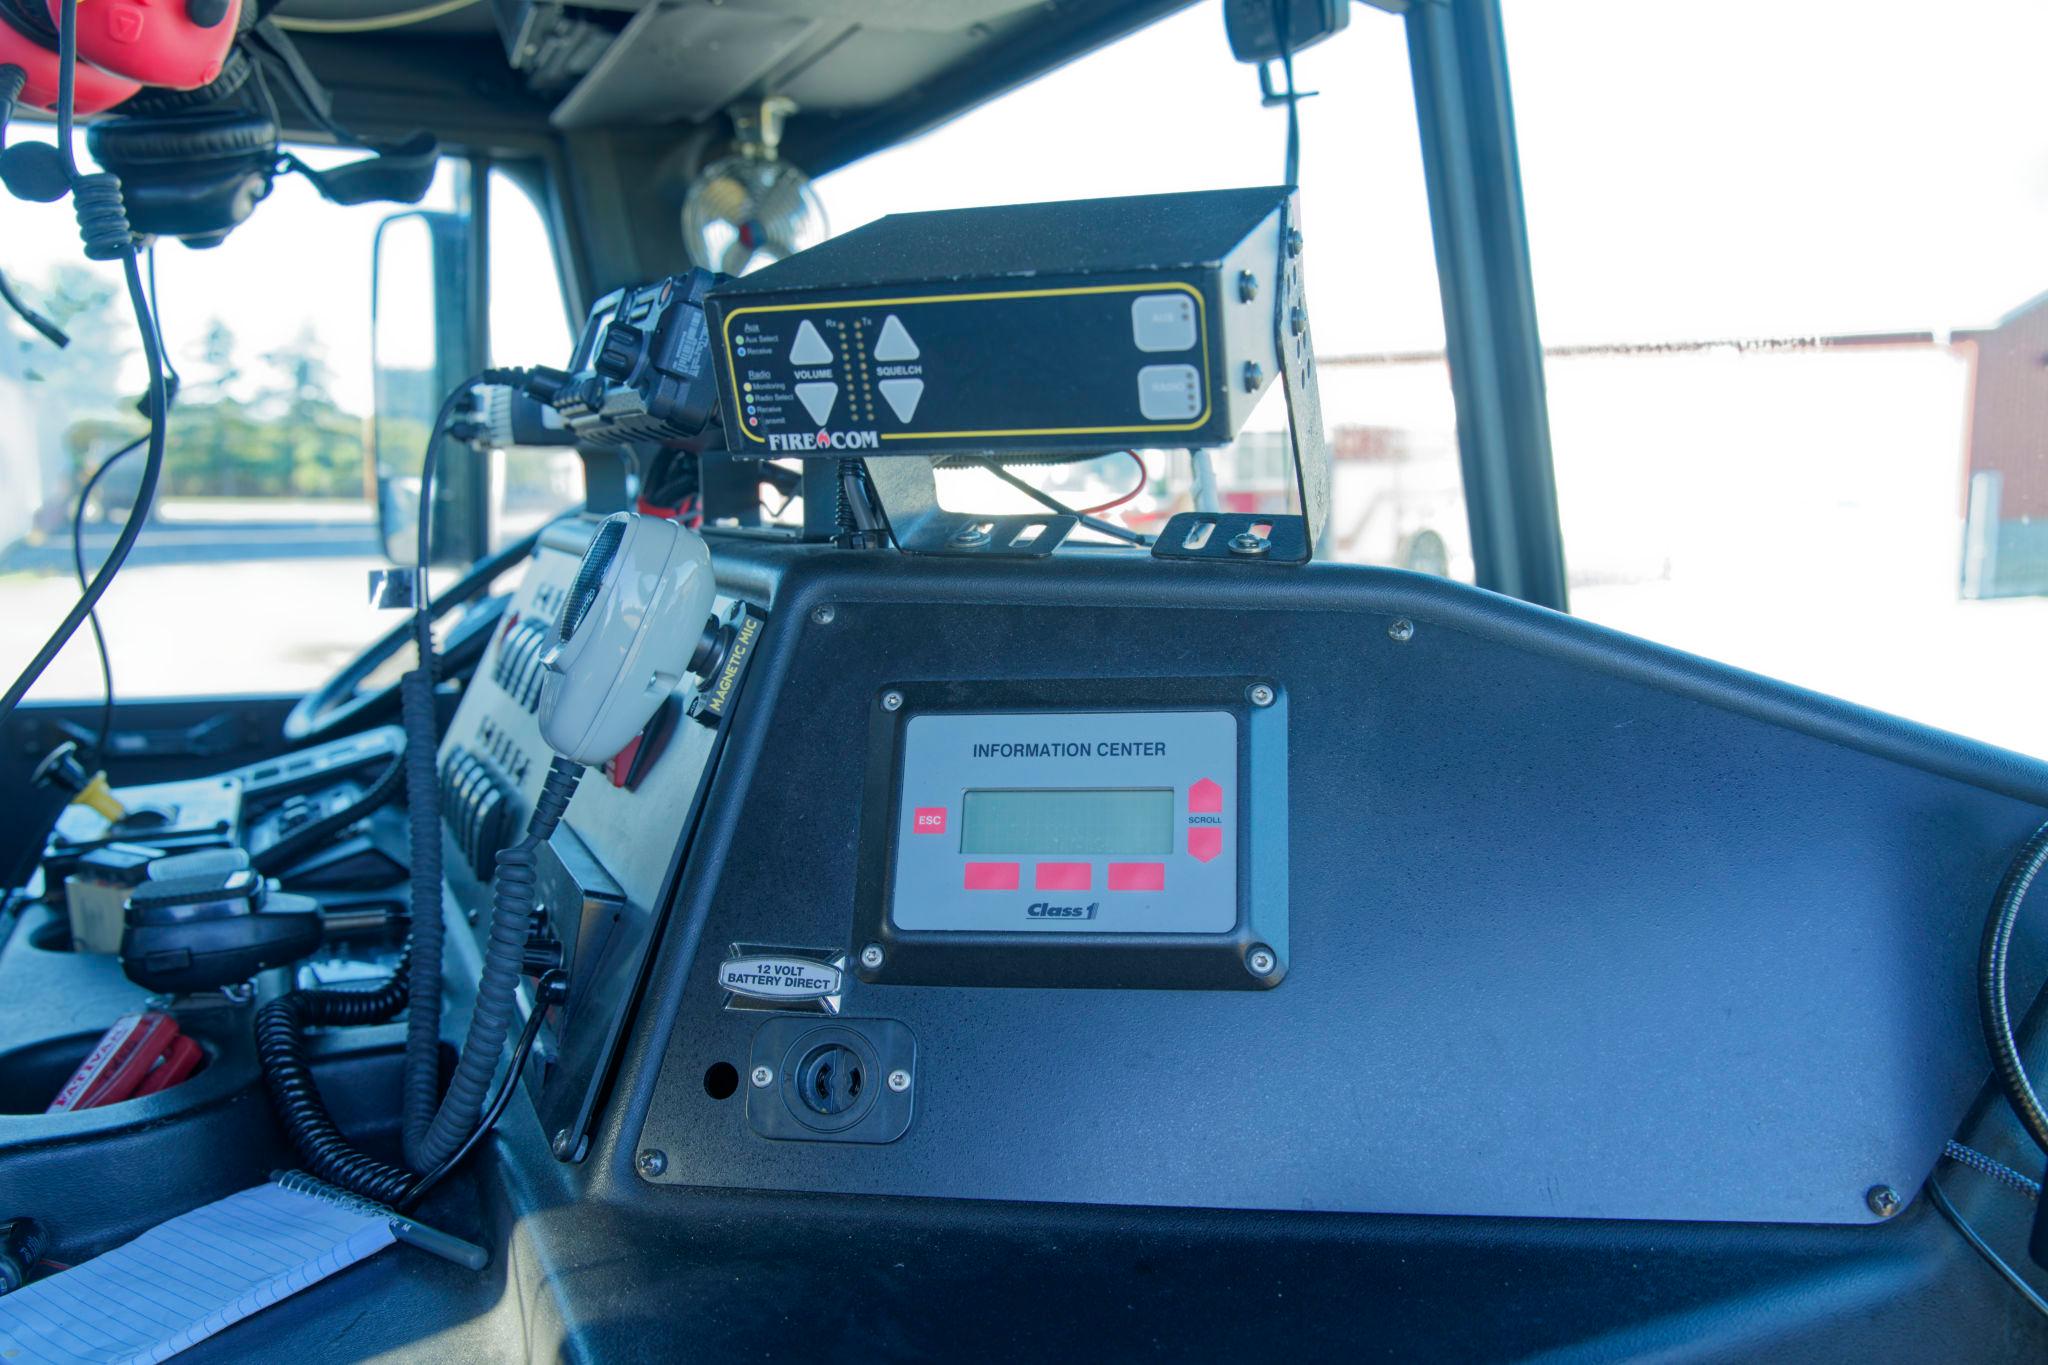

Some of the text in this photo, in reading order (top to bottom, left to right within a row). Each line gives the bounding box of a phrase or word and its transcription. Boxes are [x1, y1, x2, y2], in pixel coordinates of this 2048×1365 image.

[826, 319, 837, 328] Rx
[862, 317, 872, 326] Tx
[744, 322, 760, 333] Aux
[748, 370, 771, 380] Radio
[794, 369, 833, 379] VOLUME
[876, 365, 923, 376] SQUELCH
[709, 619, 757, 712] MAGNETIC MIC
[973, 742, 1167, 758] INFORMATION CENTER
[918, 815, 942, 825] ESC
[1188, 816, 1223, 824] SCROLL
[1027, 902, 1083, 917] Class
[757, 964, 804, 976] 12 VOLT
[727, 973, 830, 990] BATTERY DIRECT
